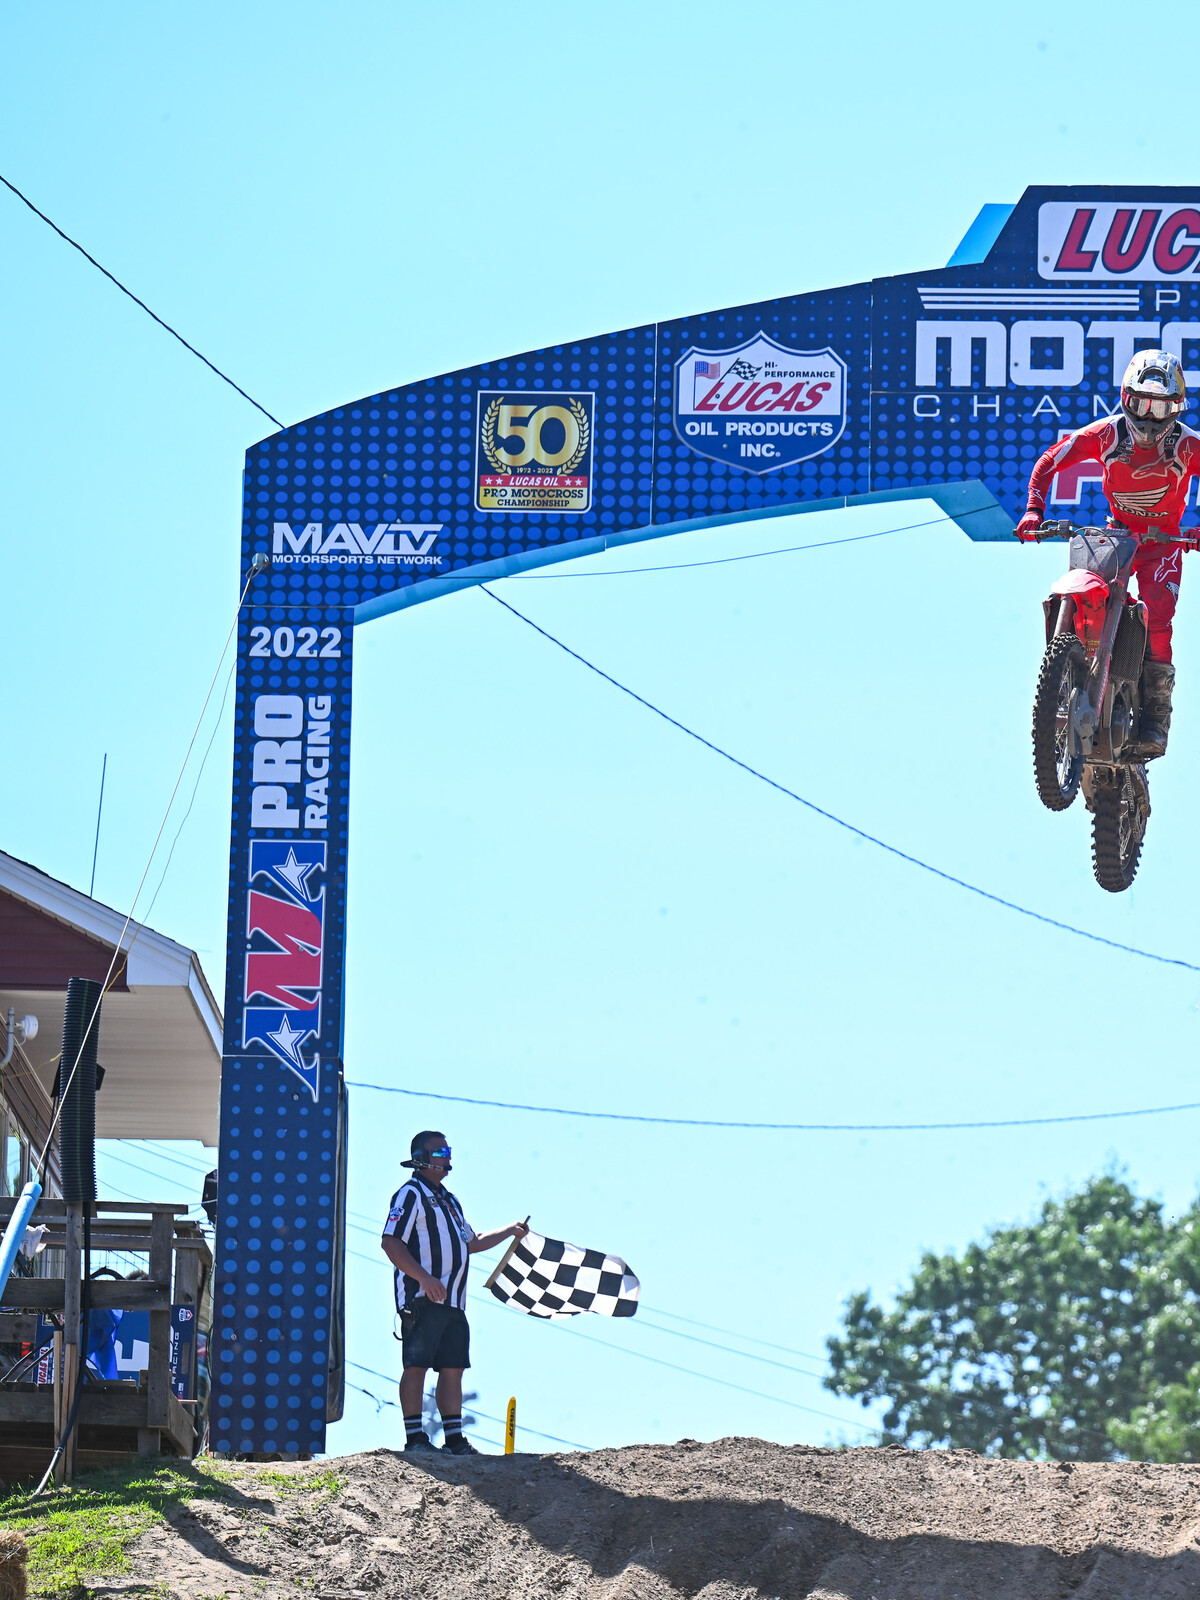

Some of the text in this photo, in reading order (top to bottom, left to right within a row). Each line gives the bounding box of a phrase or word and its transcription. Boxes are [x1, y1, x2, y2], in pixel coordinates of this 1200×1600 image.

[764, 361, 778, 369] HI-
[694, 382, 832, 412] LUCAS
[494, 405, 580, 467] 50
[685, 421, 834, 437] OIL PRODUCTS
[509, 476, 559, 486] LUCAS OIL
[483, 488, 584, 499] PRO MOTOCROSS
[497, 498, 570, 507] CHAMPIONSHIP
[1112, 501, 1170, 518] HONDA
[272, 522, 443, 555] MAVTV
[272, 554, 443, 565] MOTORSPORTS NETWORK
[249, 626, 341, 658] 2022
[251, 695, 303, 829] PRO
[304, 695, 332, 829] RACING
[38, 1361, 48, 1384] UCAS
